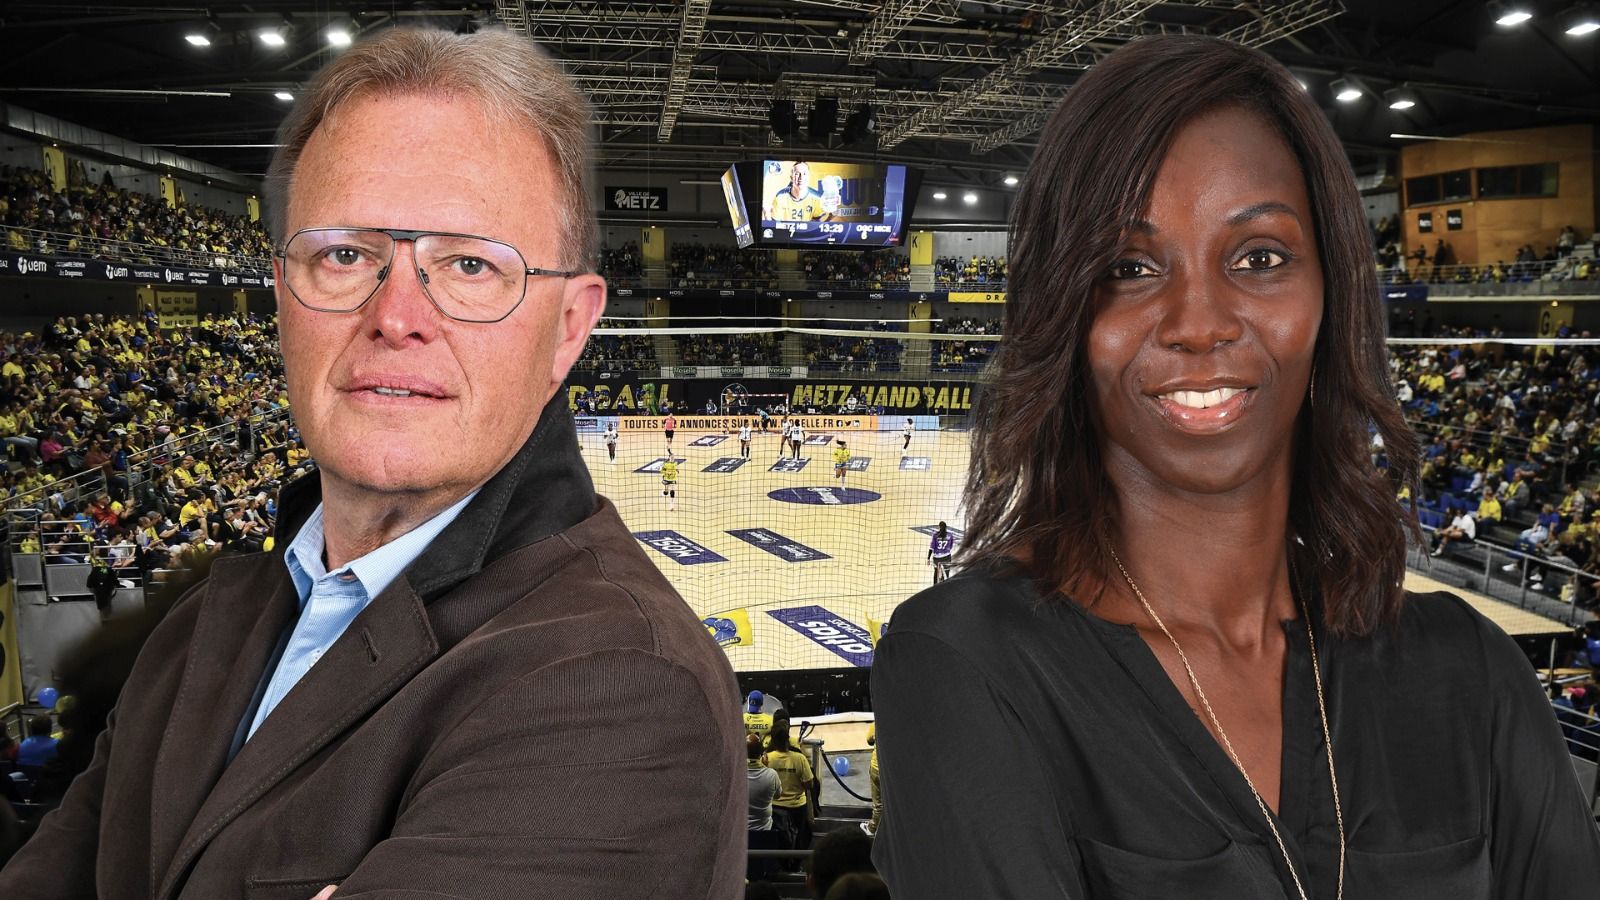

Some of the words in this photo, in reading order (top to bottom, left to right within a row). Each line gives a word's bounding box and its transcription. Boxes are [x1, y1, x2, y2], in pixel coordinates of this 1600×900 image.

[616, 196, 660, 209] METZ
[912, 234, 918, 249] K
[911, 305, 917, 319] K
[791, 384, 850, 406] METZ
[859, 385, 972, 410] HANDBALL
[624, 419, 658, 429] TOUTES
[679, 419, 729, 429] ANNONCES
[937, 540, 948, 550] 37
